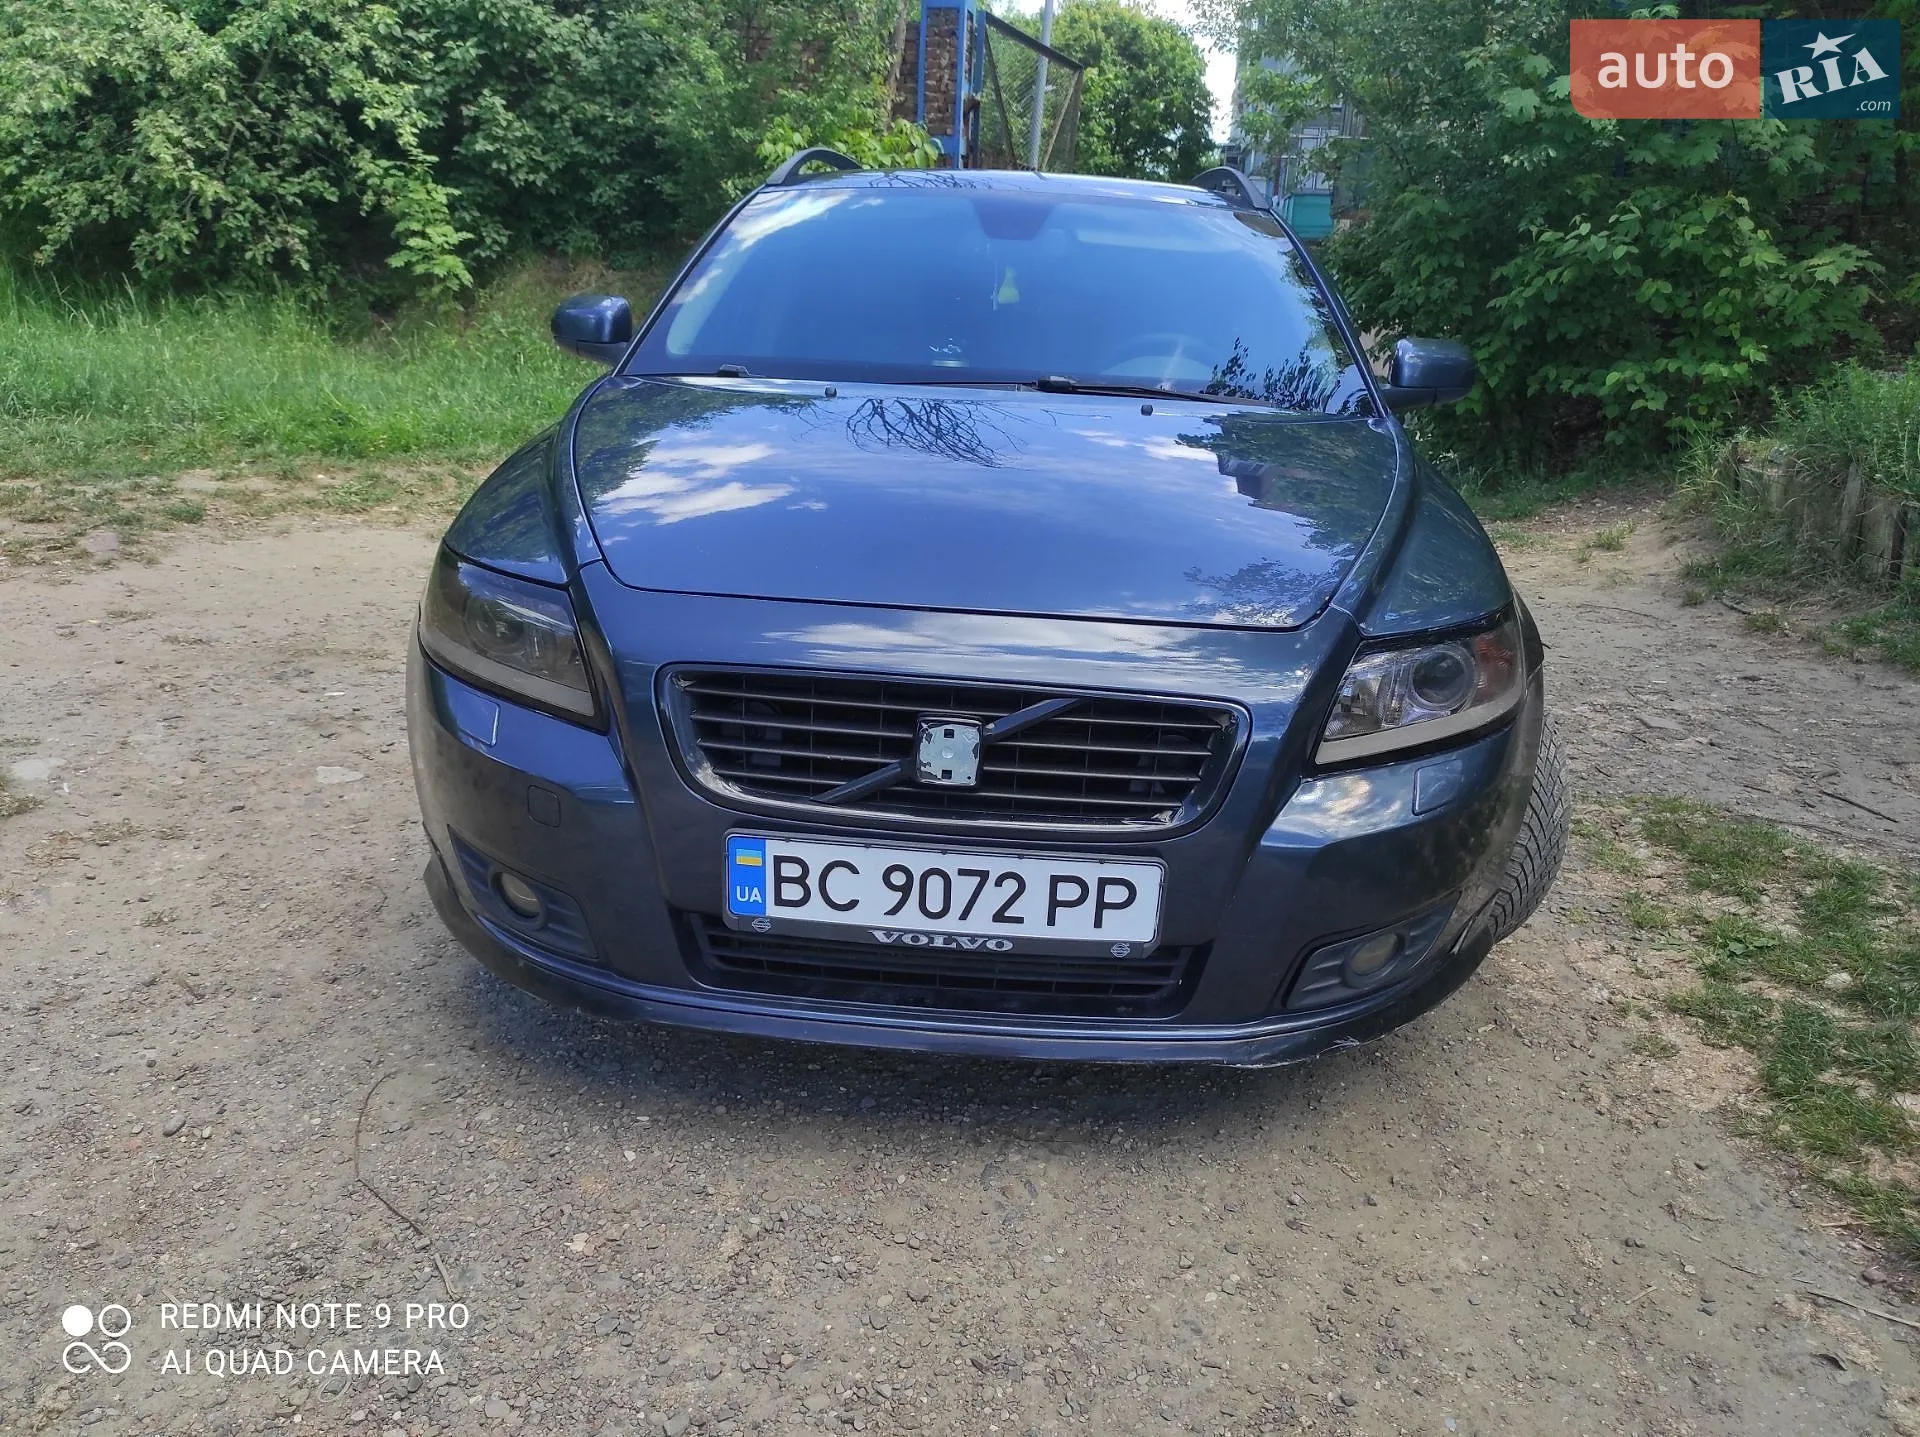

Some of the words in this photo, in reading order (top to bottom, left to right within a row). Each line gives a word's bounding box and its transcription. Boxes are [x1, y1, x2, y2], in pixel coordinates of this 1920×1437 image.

[735, 886, 763, 904] UA
[773, 855, 860, 911] BC
[882, 863, 1026, 924] 9072
[1047, 874, 1137, 929] PP
[867, 929, 1014, 952] VOLVO
